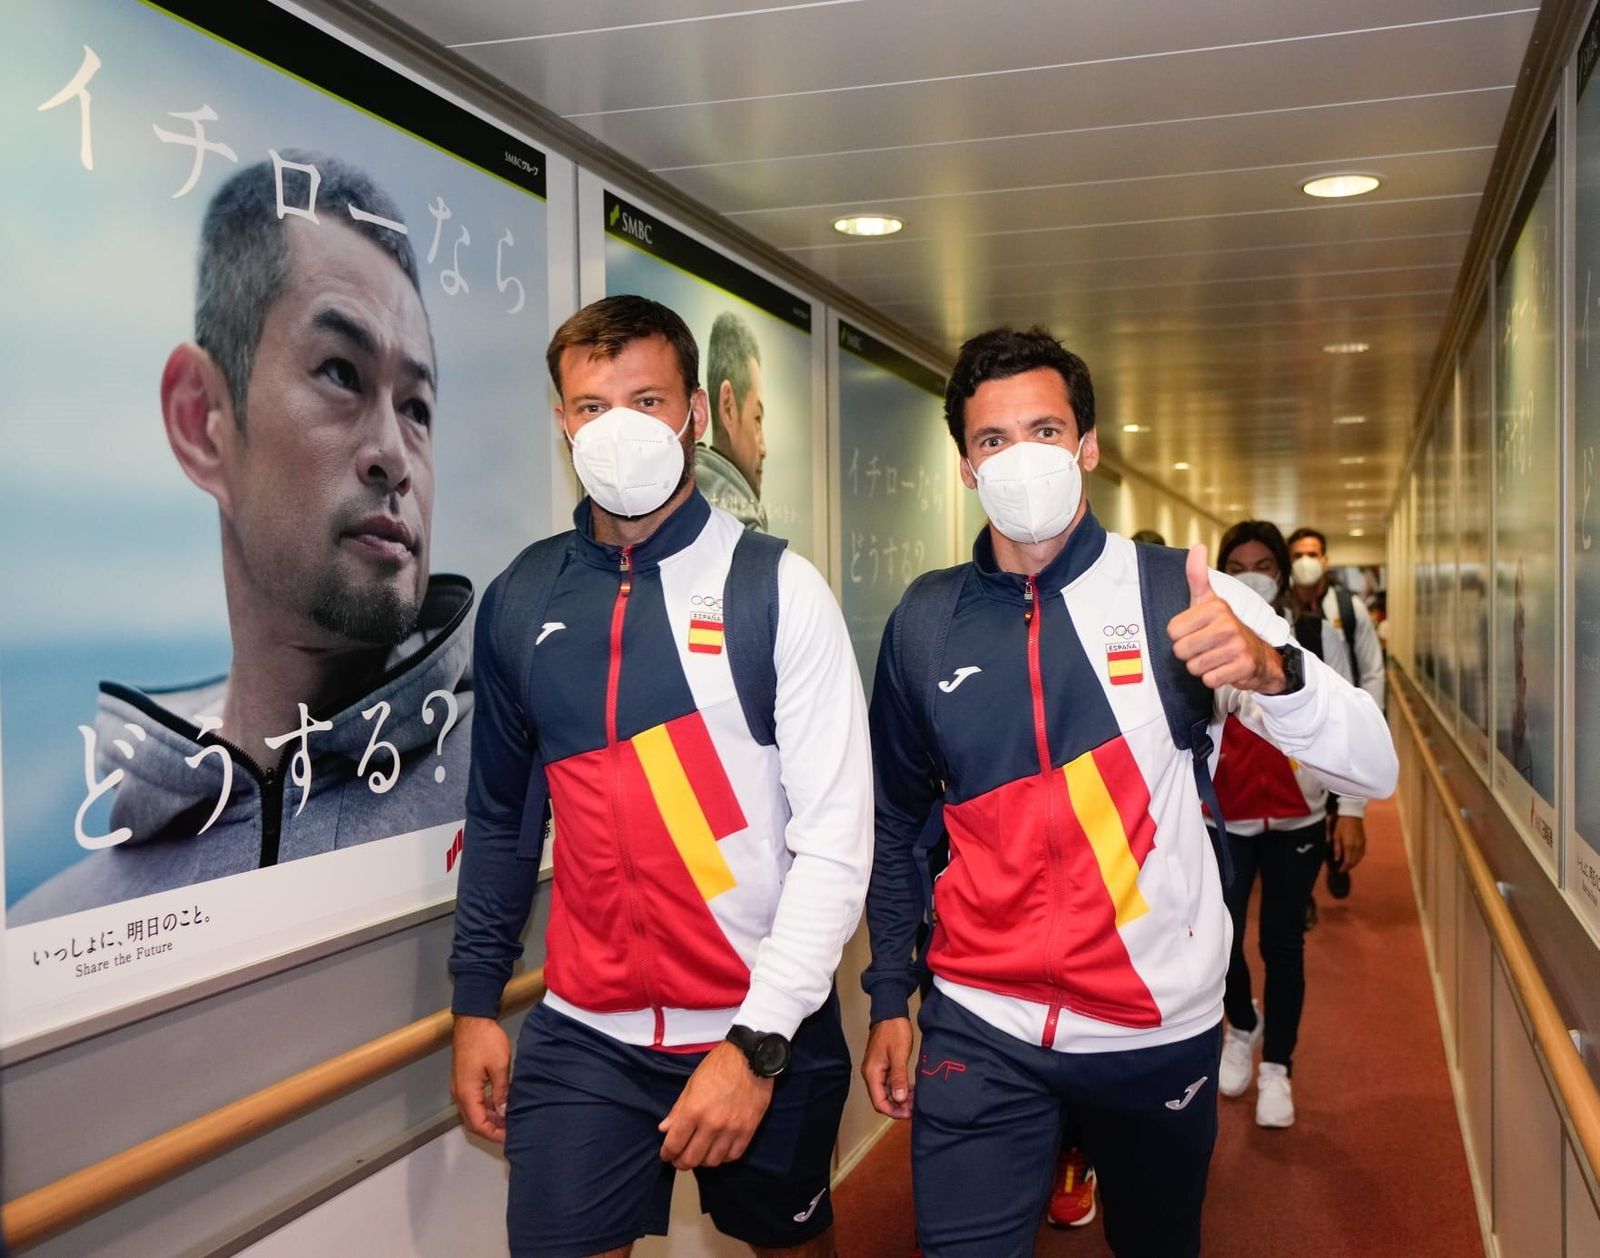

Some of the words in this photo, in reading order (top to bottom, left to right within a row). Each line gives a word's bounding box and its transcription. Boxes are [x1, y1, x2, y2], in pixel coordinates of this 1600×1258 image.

[37, 45, 525, 314] イチローなら
[622, 212, 653, 244] SMBC
[1108, 642, 1137, 651] ESPAÑA
[74, 689, 459, 850] どうする?
[33, 905, 210, 966] いっしょに、明日のこと。
[75, 957, 110, 977] Share
[114, 951, 132, 966] the
[136, 941, 173, 960] Future
